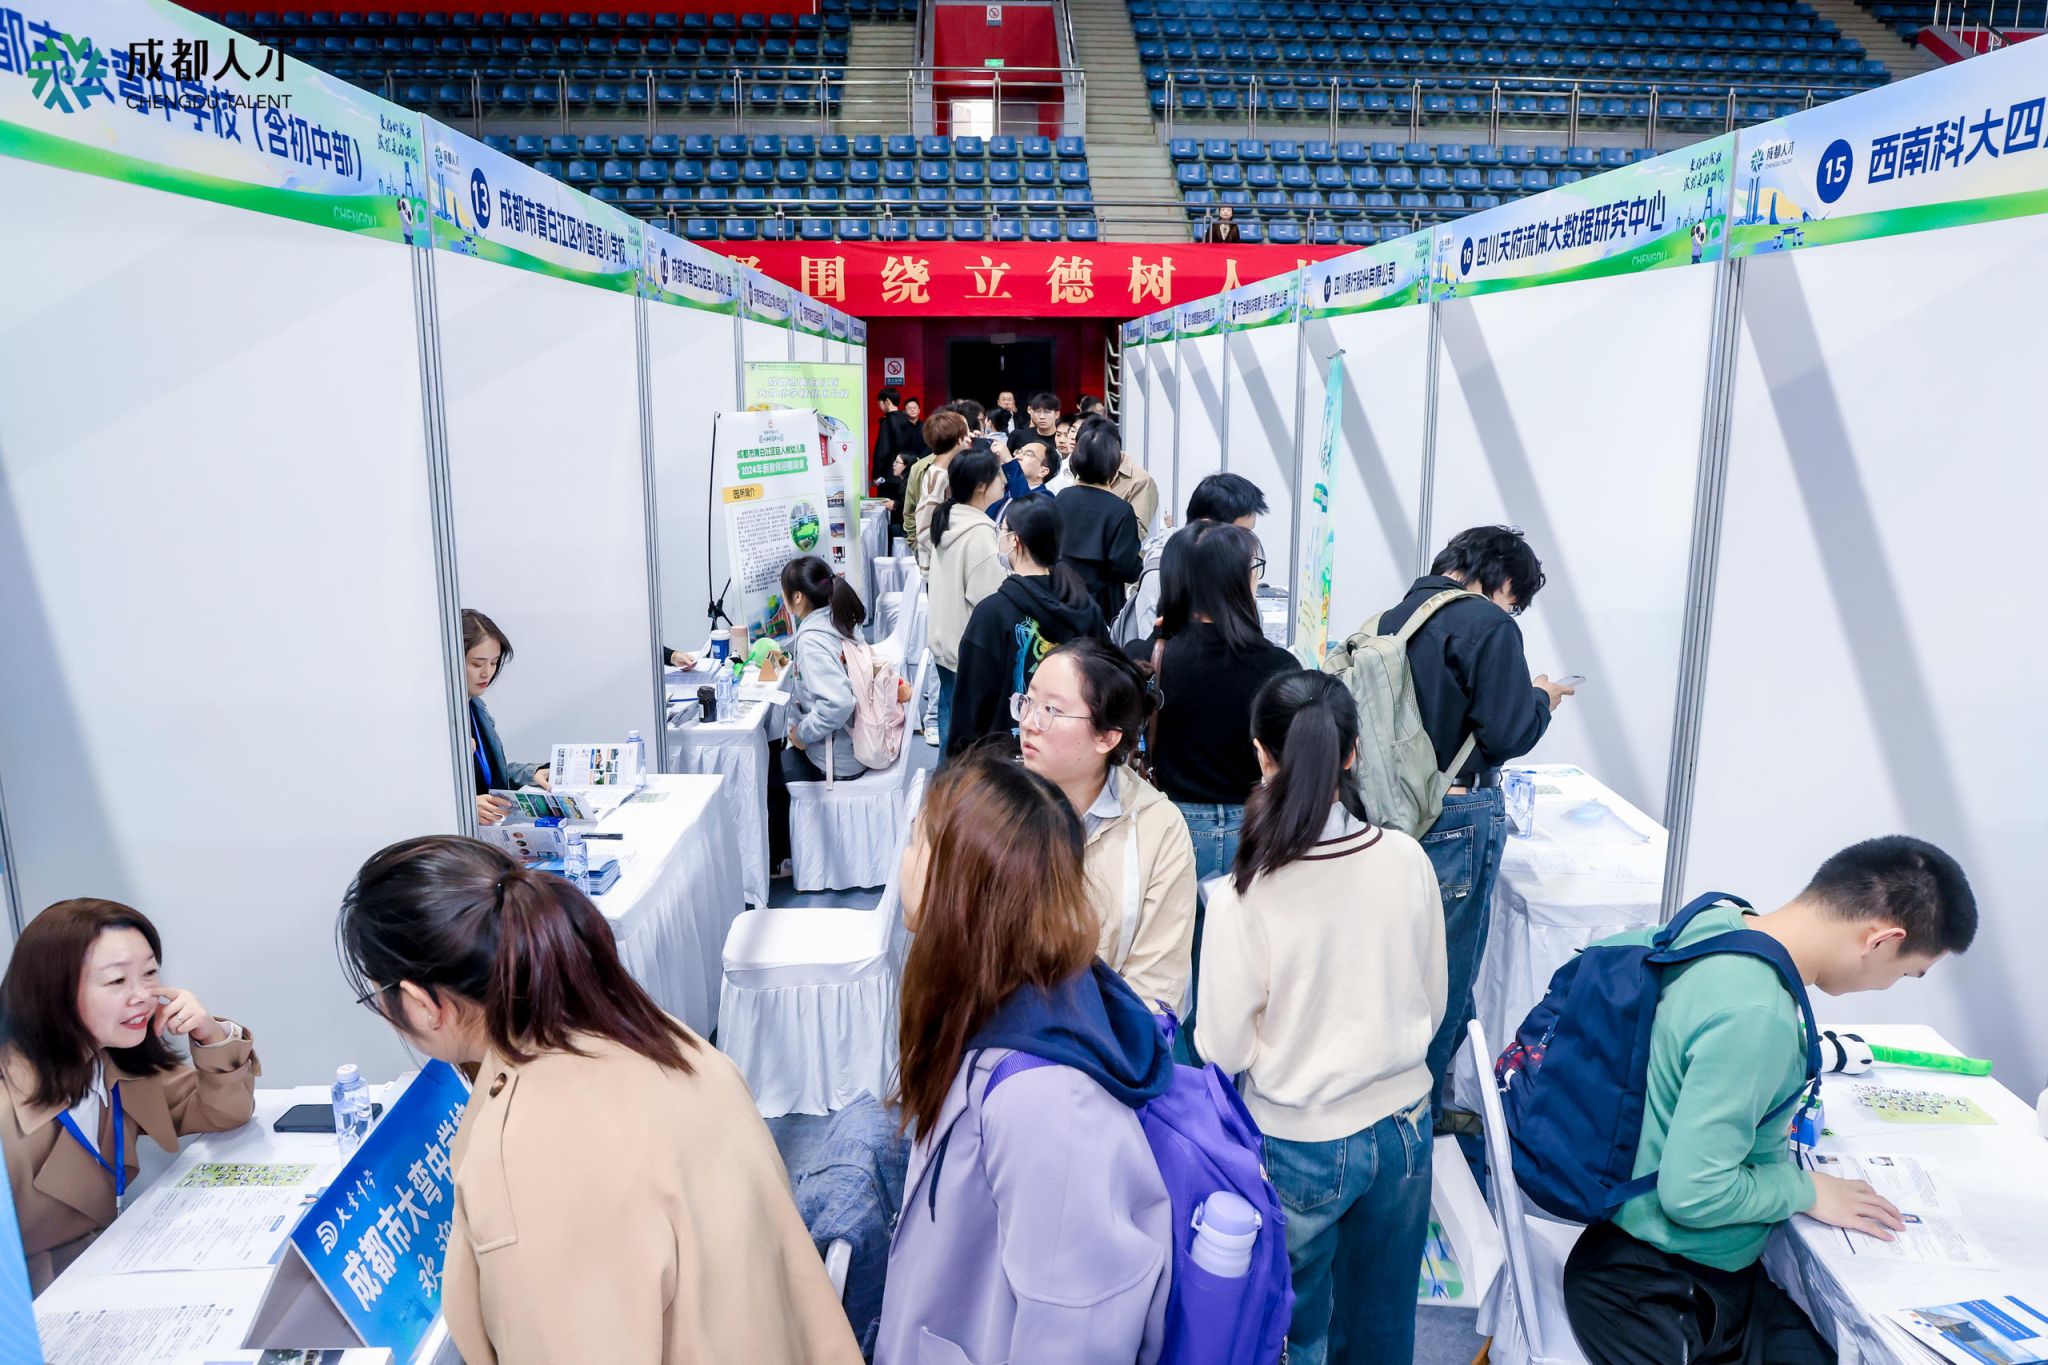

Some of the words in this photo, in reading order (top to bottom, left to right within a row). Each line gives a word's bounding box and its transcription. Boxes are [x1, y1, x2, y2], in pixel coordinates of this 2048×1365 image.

[1766, 141, 1795, 160] 成都人才
[1868, 97, 2048, 184] 西南科大四
[1825, 156, 1847, 185] 15
[472, 181, 489, 217] 13
[500, 188, 627, 266] 成都市青白江区外国语小学校
[1476, 189, 1666, 267] 四川天府流体大数据研究中心
[1463, 247, 1472, 265] 16
[728, 254, 1319, 305] 围绕立德树人
[1334, 261, 1396, 296] 四川银行股份有限公司
[1444, 832, 1462, 840] Jeep
